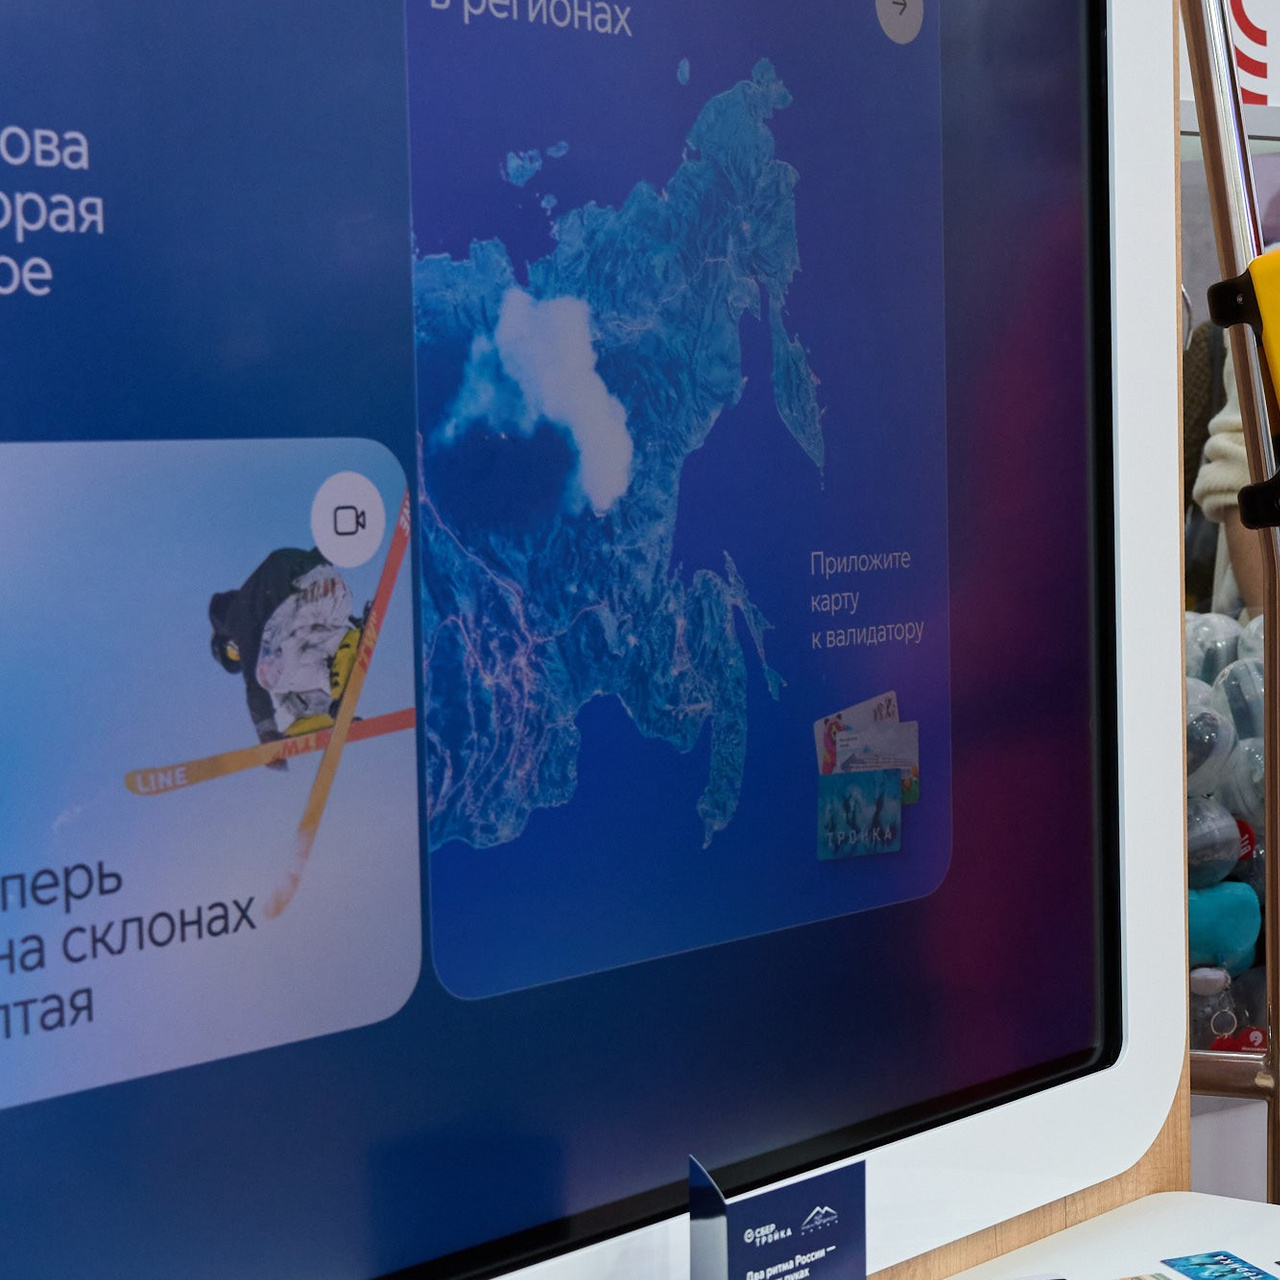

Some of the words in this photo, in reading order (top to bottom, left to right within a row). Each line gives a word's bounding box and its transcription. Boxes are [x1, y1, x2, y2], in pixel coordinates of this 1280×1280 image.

[810, 551, 911, 580] Приложите
[811, 590, 860, 615] карту
[811, 631, 822, 649] к
[826, 620, 925, 649] валидатору
[136, 765, 189, 795] LINE
[62, 896, 257, 963] склонах
[755, 1227, 793, 1247] ТРОЙКА
[766, 1260, 794, 1280] ритма
[795, 1248, 826, 1267] России
